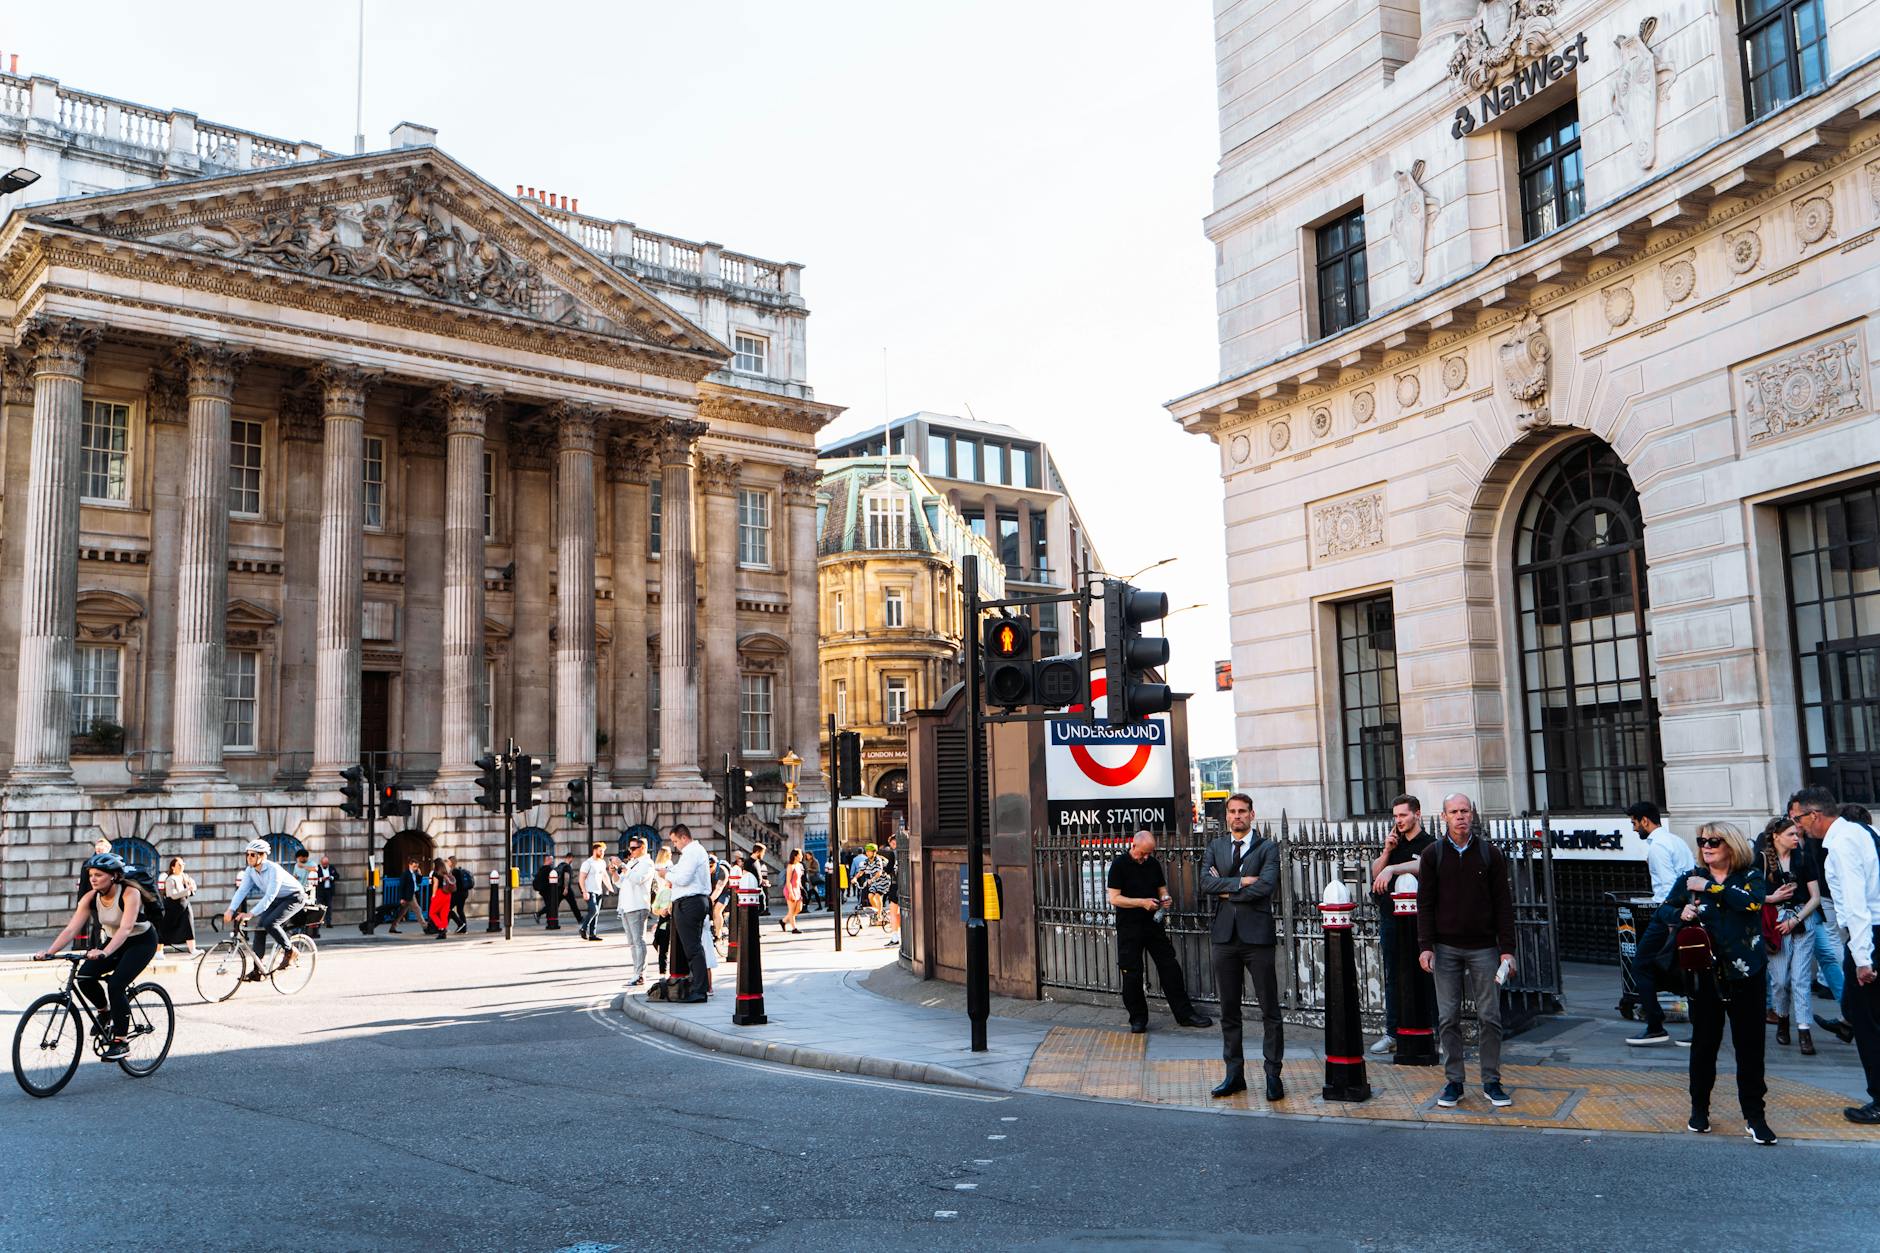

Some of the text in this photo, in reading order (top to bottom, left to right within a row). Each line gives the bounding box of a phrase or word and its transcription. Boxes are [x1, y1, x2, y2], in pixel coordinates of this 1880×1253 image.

[1480, 31, 1589, 123] NatWest
[1057, 723, 1160, 741] UNDERGROUND
[1060, 807, 1165, 826] BANK STATION
[1551, 829, 1624, 850] NatWest
[1621, 942, 1636, 953] FREE
